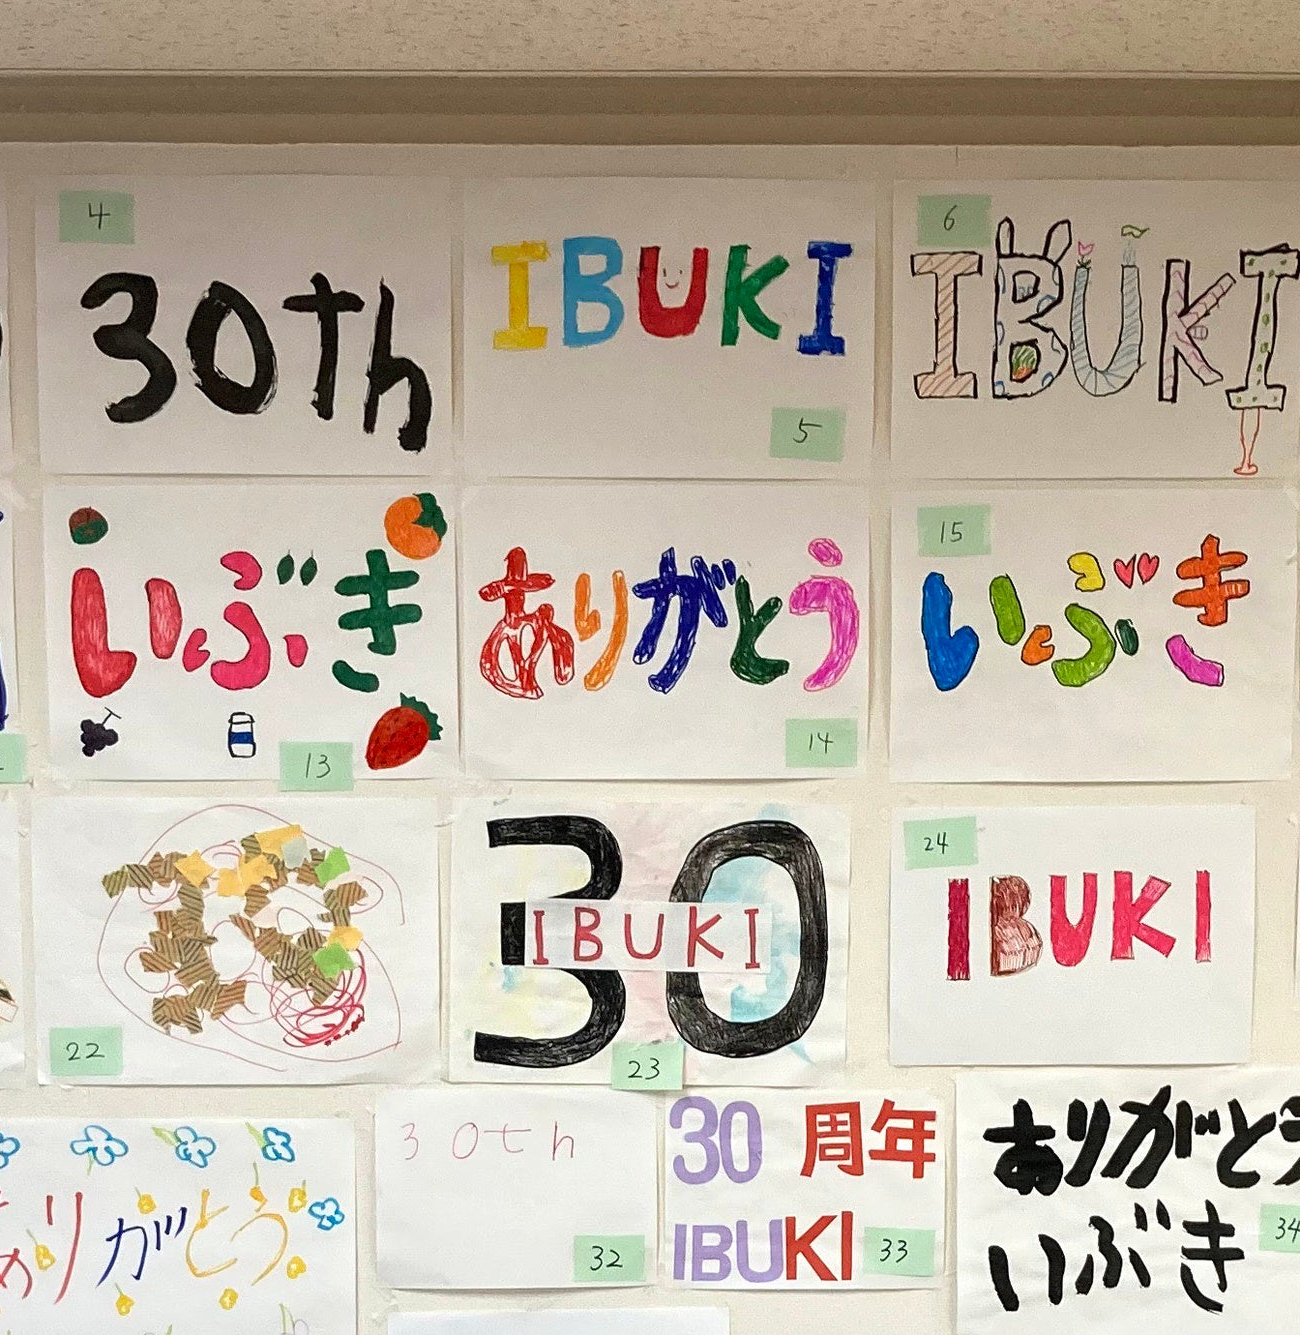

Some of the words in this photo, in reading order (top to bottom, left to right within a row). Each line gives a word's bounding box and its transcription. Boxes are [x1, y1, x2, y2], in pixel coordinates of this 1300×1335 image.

[88, 202, 112, 227] 4
[944, 205, 956, 231] 6
[491, 238, 854, 355] IBUKI
[79, 271, 433, 454] 30th
[793, 417, 822, 445] 5
[938, 519, 965, 544] 15
[70, 548, 424, 698] いぶき
[479, 538, 861, 700] ありがとう
[922, 536, 1250, 691] いぶき
[808, 731, 834, 755] 14
[304, 754, 332, 779] 13
[923, 832, 949, 853] 24
[474, 814, 828, 1069] 30
[533, 906, 761, 969] IBUKI
[947, 870, 1212, 981] IBUKI
[65, 1041, 106, 1063] 22
[627, 1060, 661, 1079] 23
[399, 1120, 575, 1161] 30th
[590, 1247, 624, 1270] 32
[673, 1210, 853, 1282] IBUKI
[880, 1240, 909, 1262] 33
[988, 1199, 1245, 1315] いぶき
